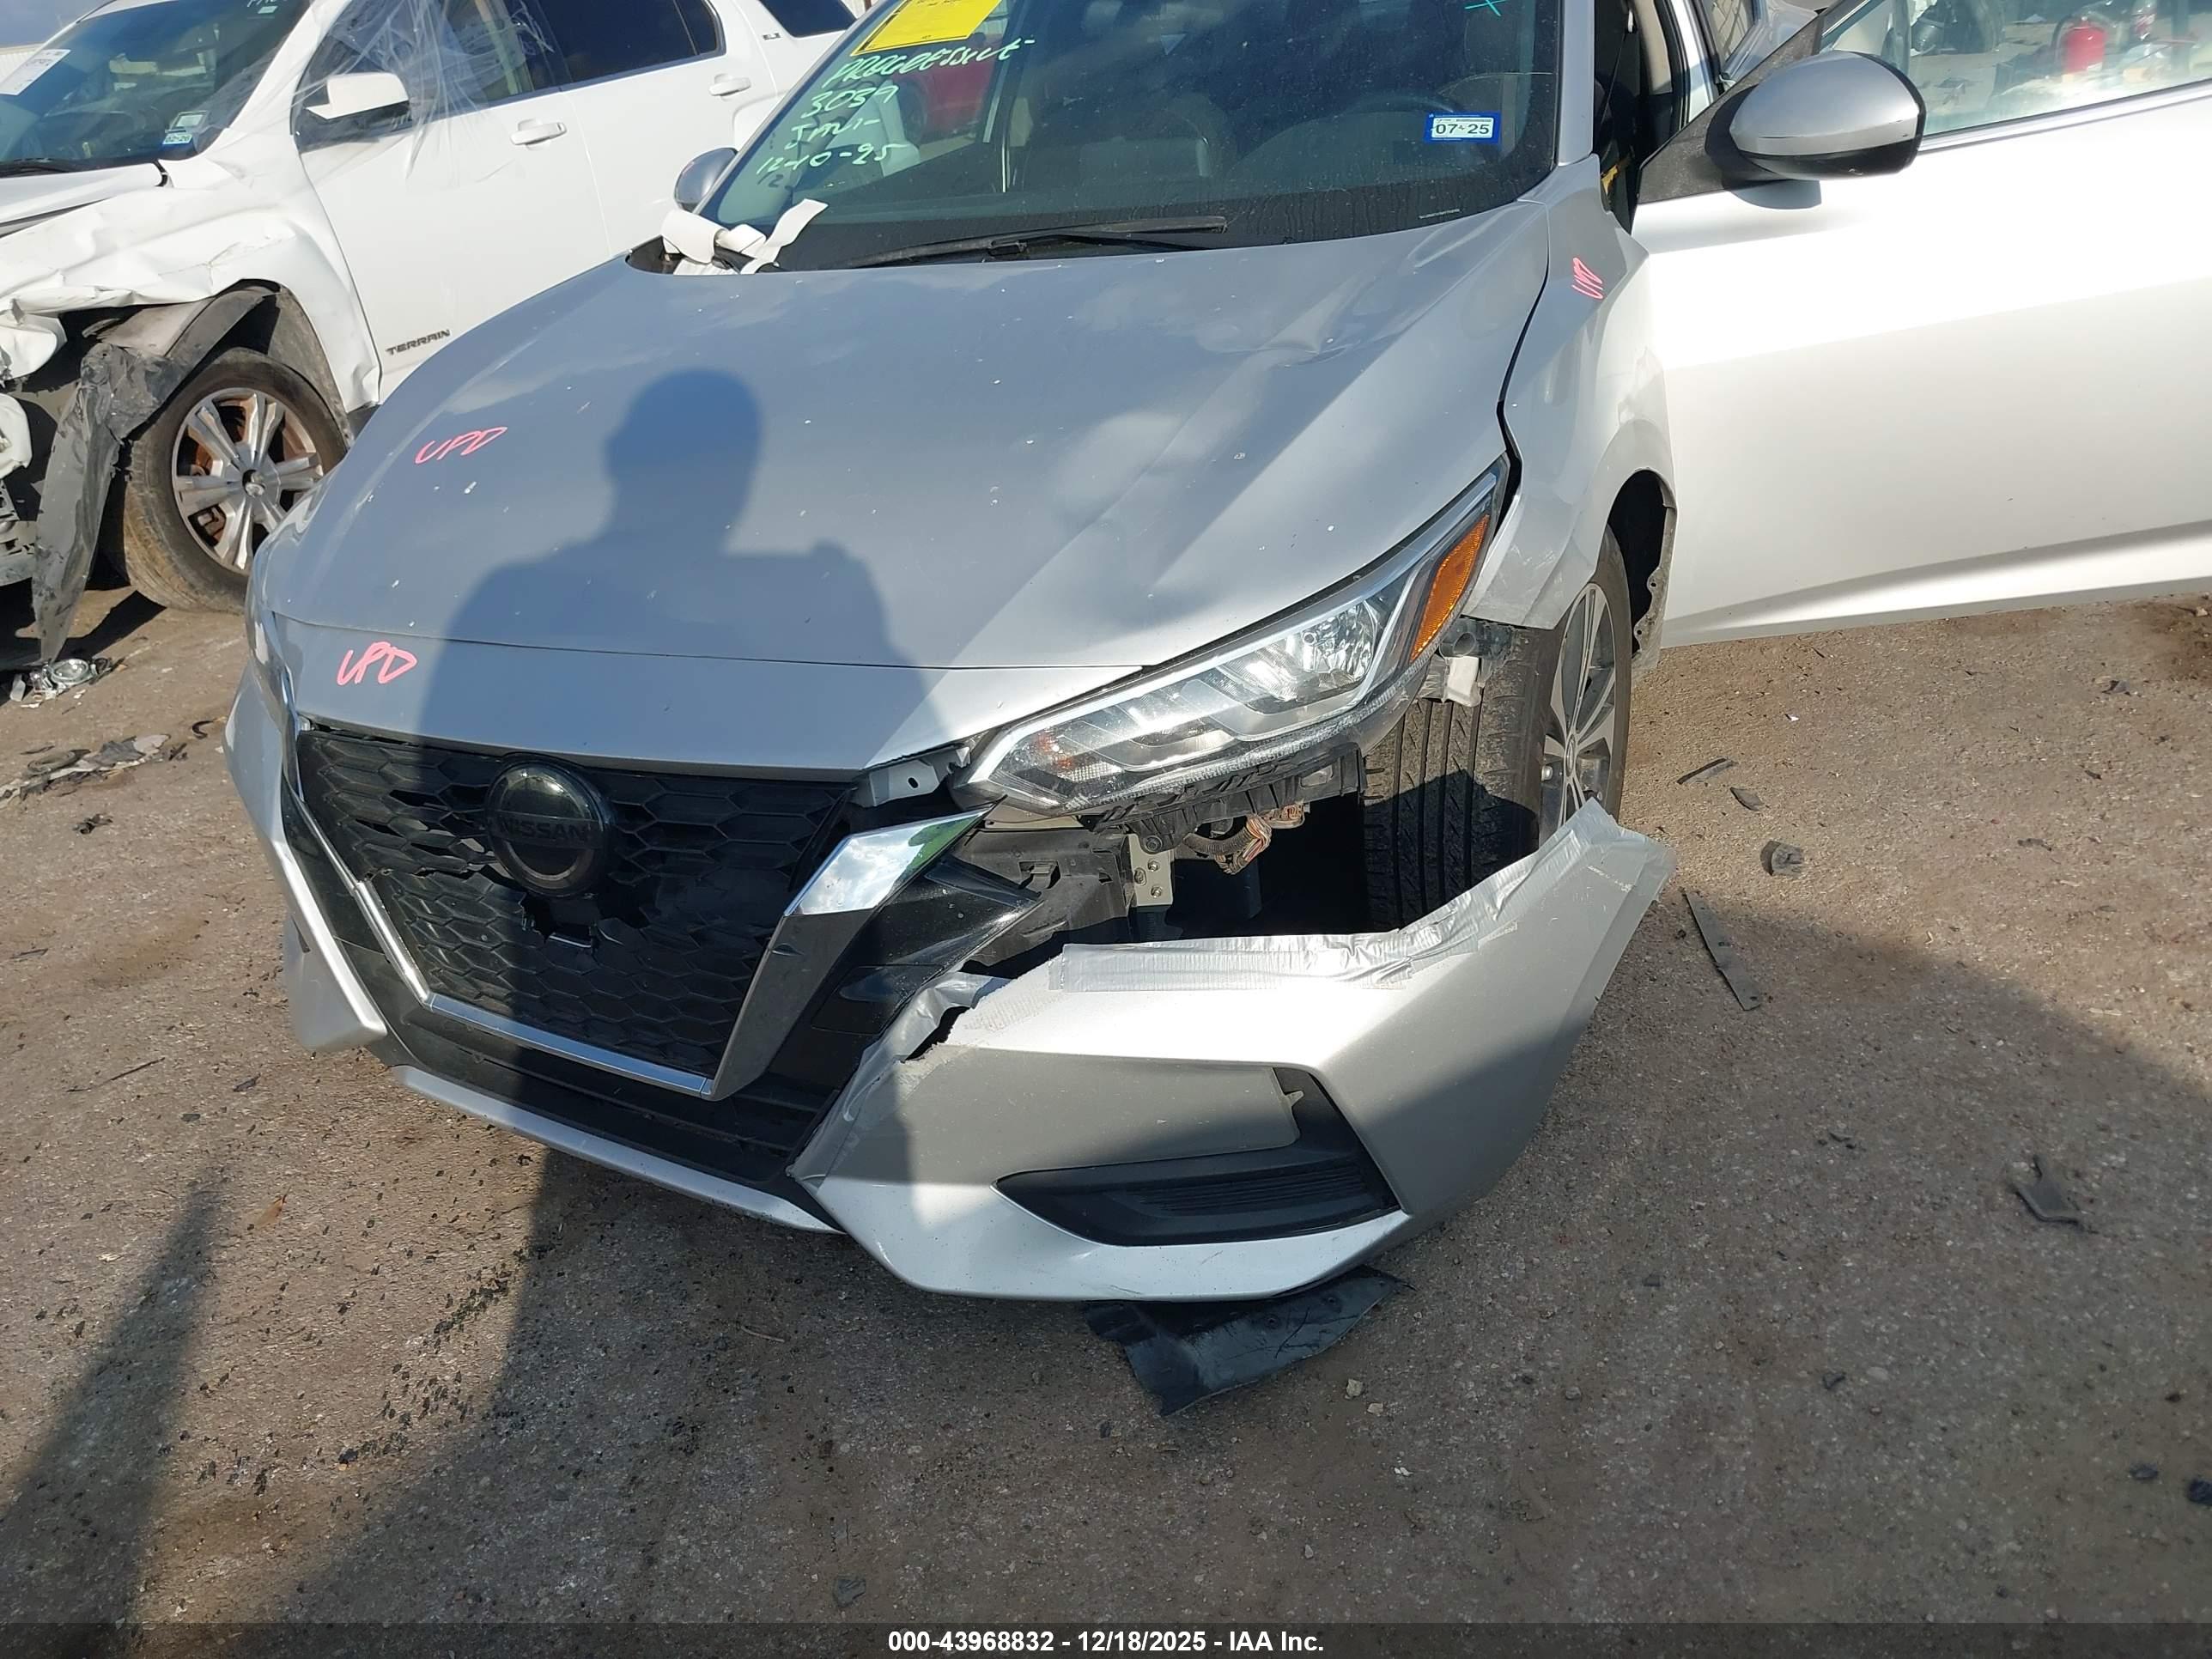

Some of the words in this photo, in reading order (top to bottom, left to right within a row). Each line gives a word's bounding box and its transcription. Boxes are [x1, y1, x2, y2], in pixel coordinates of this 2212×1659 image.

[385, 329, 451, 355] TERRAIN
[415, 426, 508, 465] UPD
[337, 641, 418, 685] UPD
[499, 817, 588, 842] NISSAN
